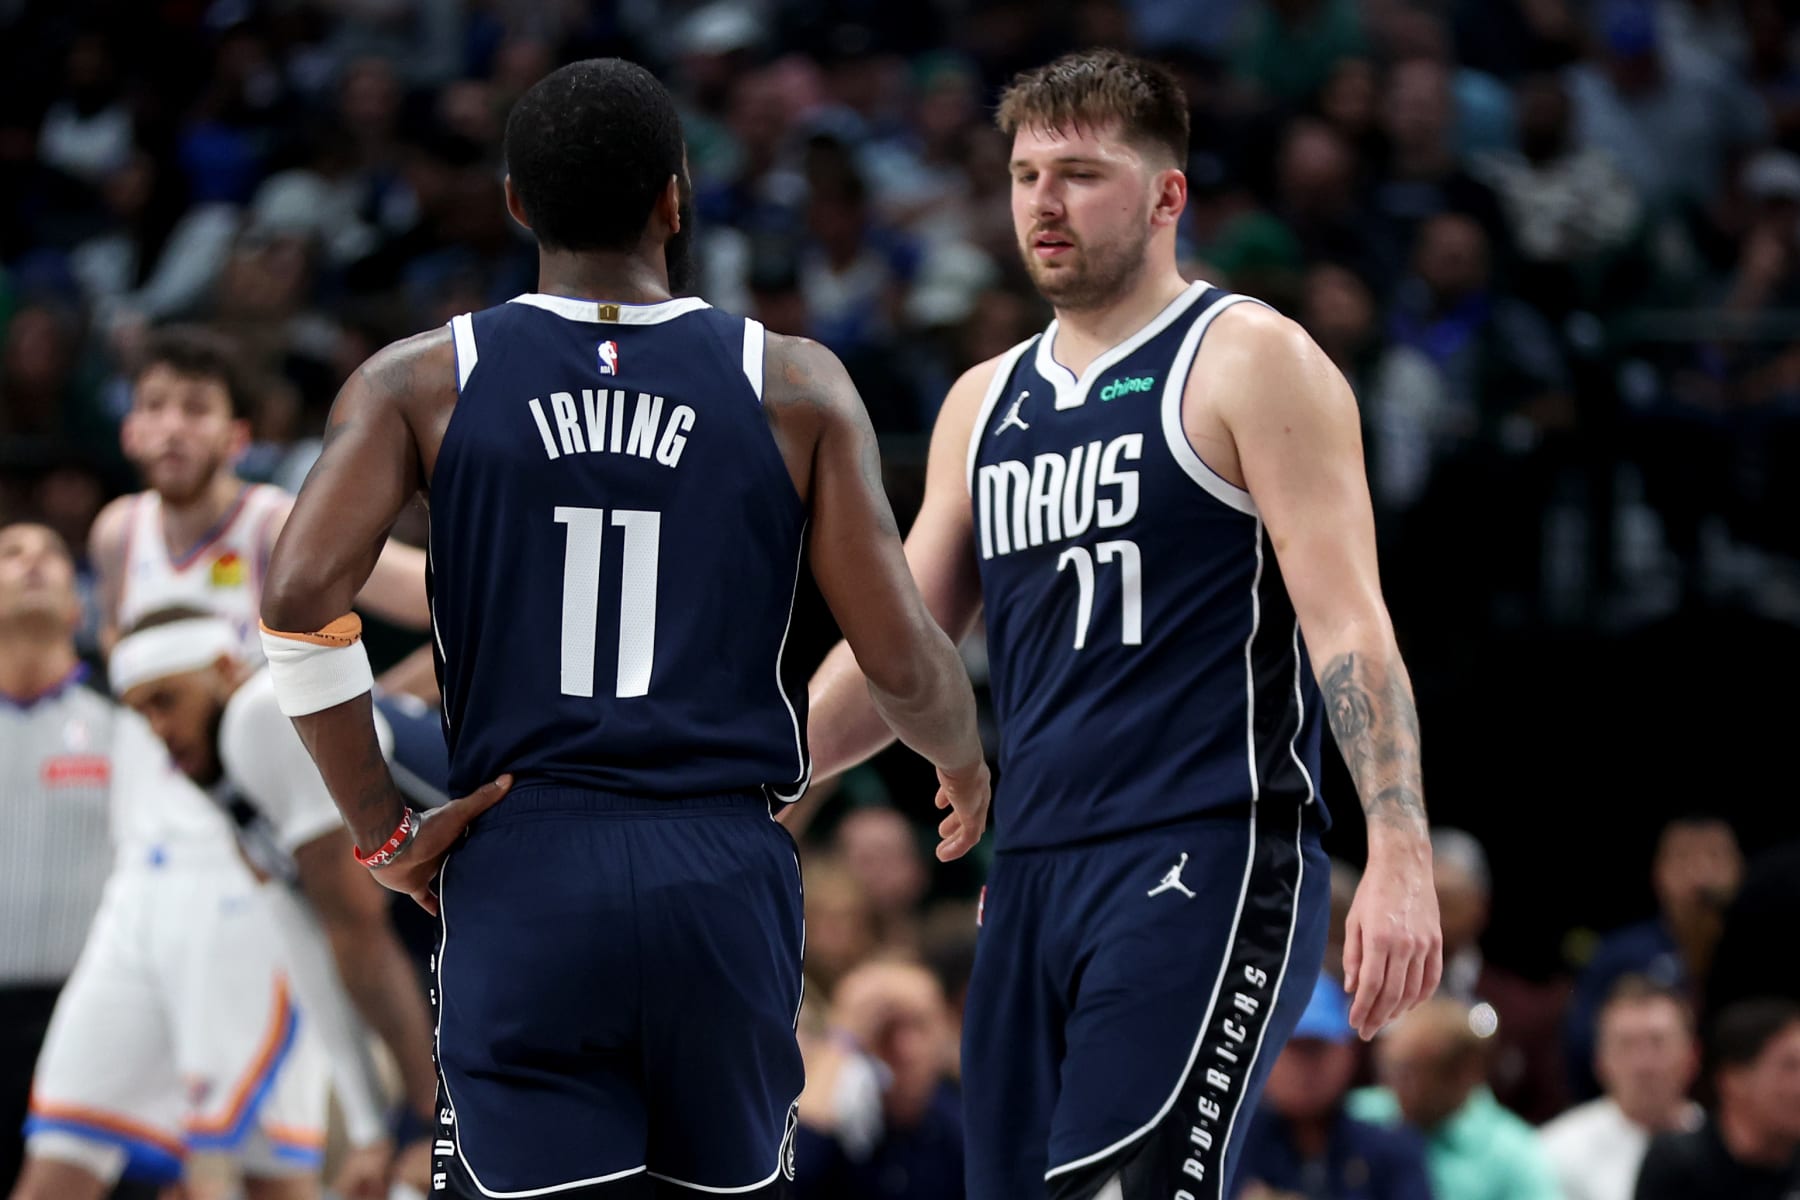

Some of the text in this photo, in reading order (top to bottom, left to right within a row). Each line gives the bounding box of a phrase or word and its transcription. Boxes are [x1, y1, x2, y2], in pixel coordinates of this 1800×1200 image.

[528, 389, 696, 468] IRVING
[1100, 376, 1155, 401] chime
[979, 433, 1144, 560] MAVS
[554, 506, 661, 698] 11
[1057, 540, 1143, 650] 77
